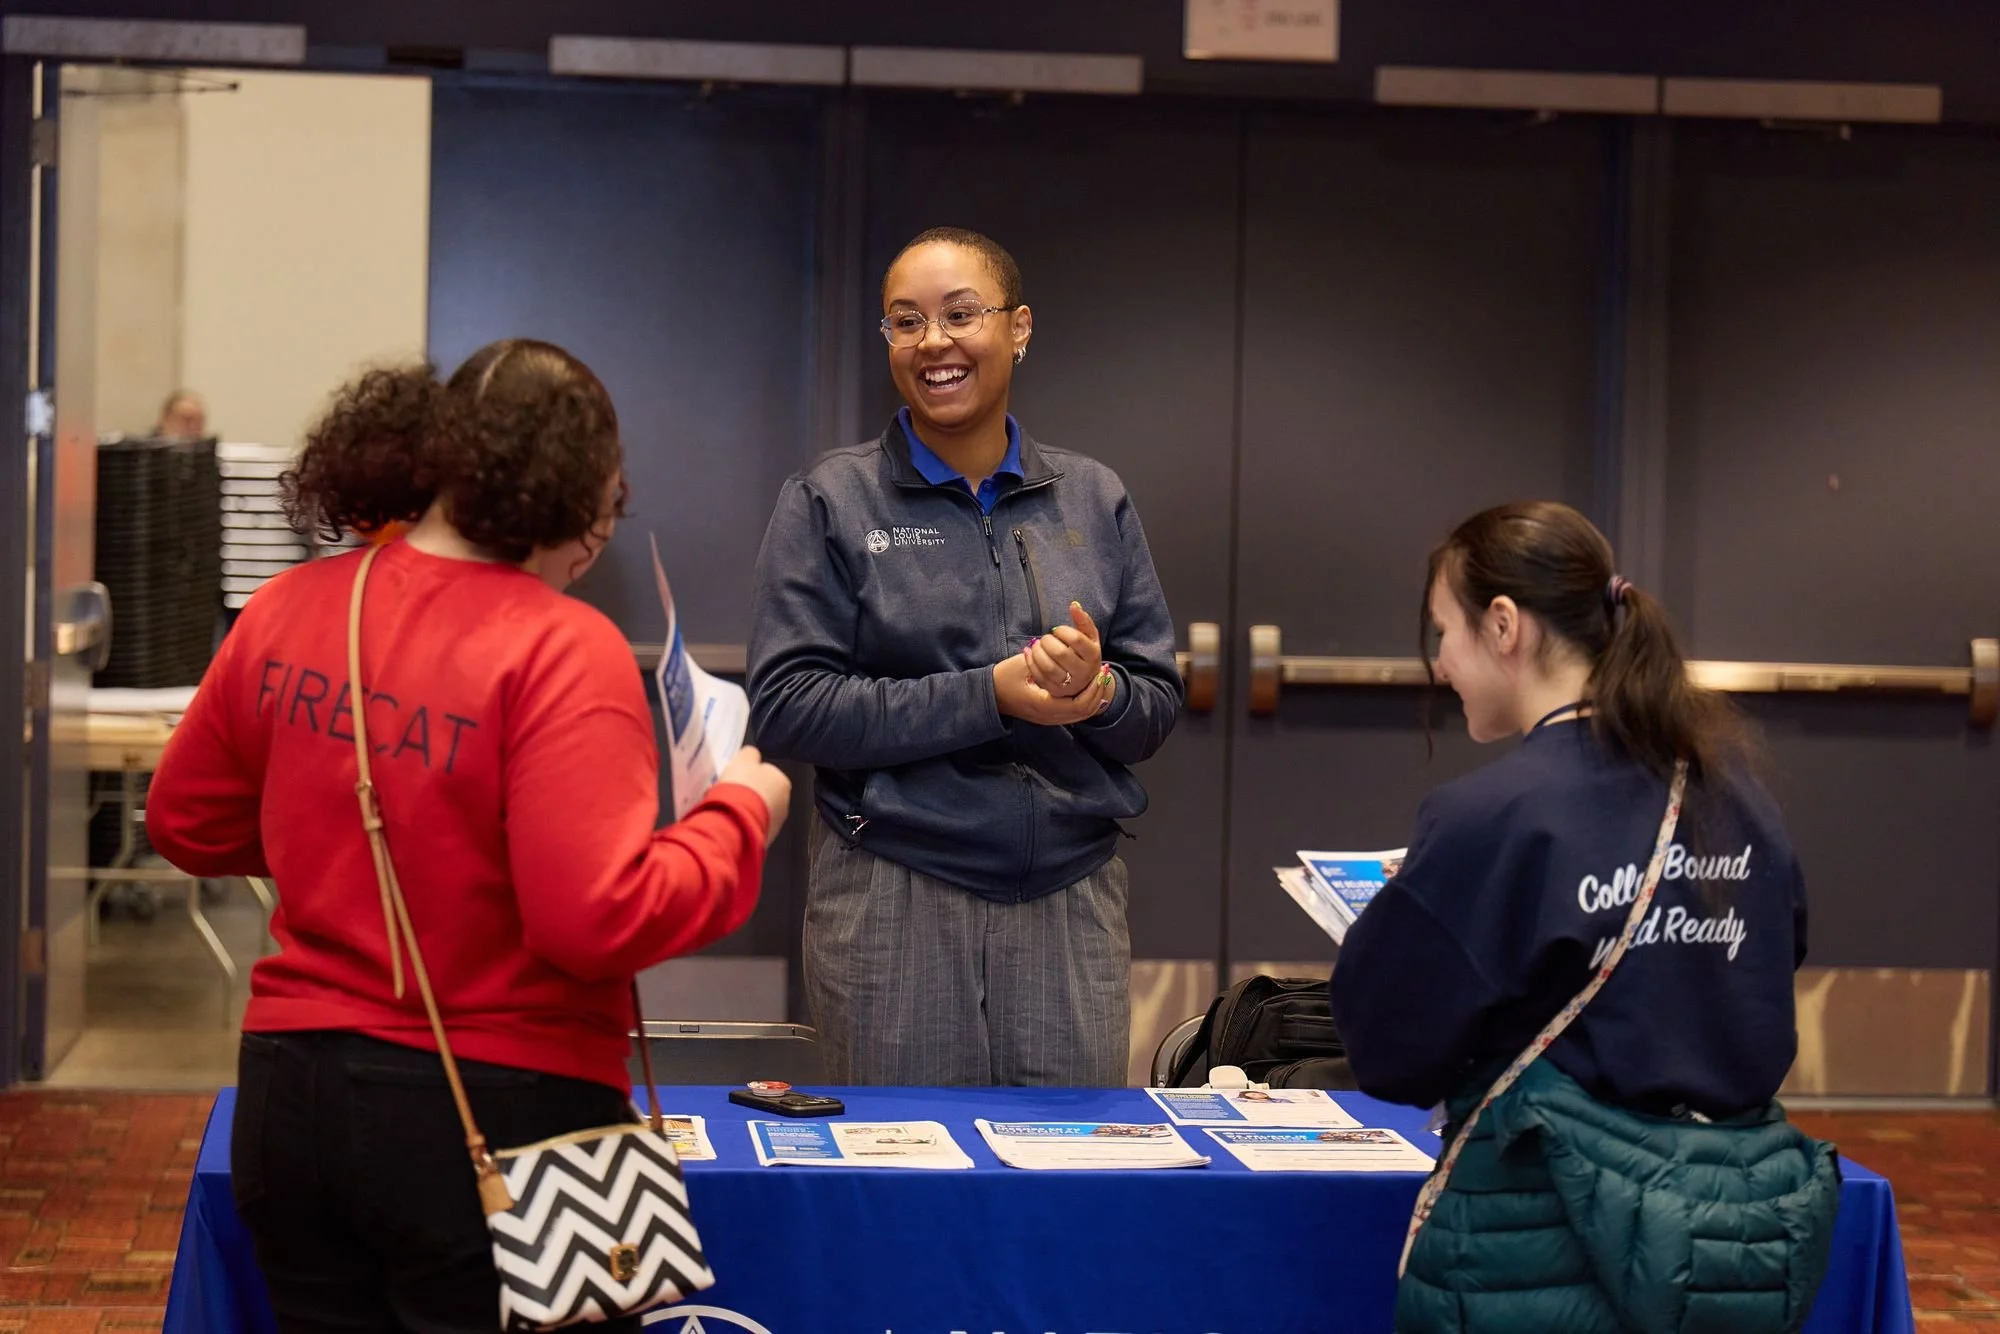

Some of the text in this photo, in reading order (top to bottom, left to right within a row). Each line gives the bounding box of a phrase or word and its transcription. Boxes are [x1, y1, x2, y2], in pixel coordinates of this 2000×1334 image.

[893, 527, 940, 535] NATIONAL
[894, 532, 920, 540] LOUIS
[895, 538, 945, 546] UNIVERSITY
[1662, 843, 1752, 881] Bound
[1664, 905, 1748, 963] Ready
